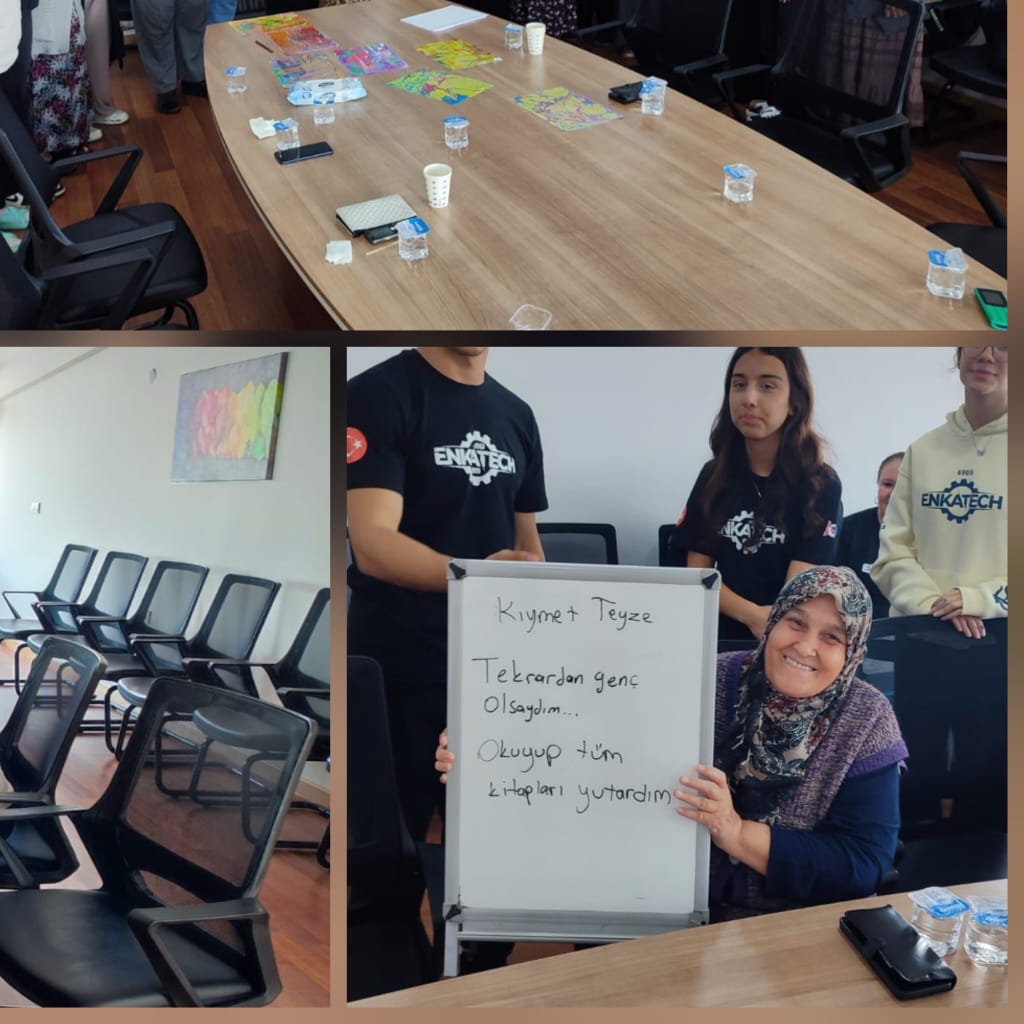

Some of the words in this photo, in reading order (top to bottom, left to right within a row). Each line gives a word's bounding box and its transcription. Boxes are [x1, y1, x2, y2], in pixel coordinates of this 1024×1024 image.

[433, 446, 516, 474] ENKATECH
[921, 493, 1004, 510] ENKATECH
[497, 596, 579, 633] Kıymet
[591, 597, 653, 631] Teyze
[472, 657, 584, 687] Tekrardan
[594, 671, 639, 694] genç
[478, 739, 562, 773] Okuyup
[576, 740, 623, 764] tüm
[576, 783, 672, 814] yutardım
